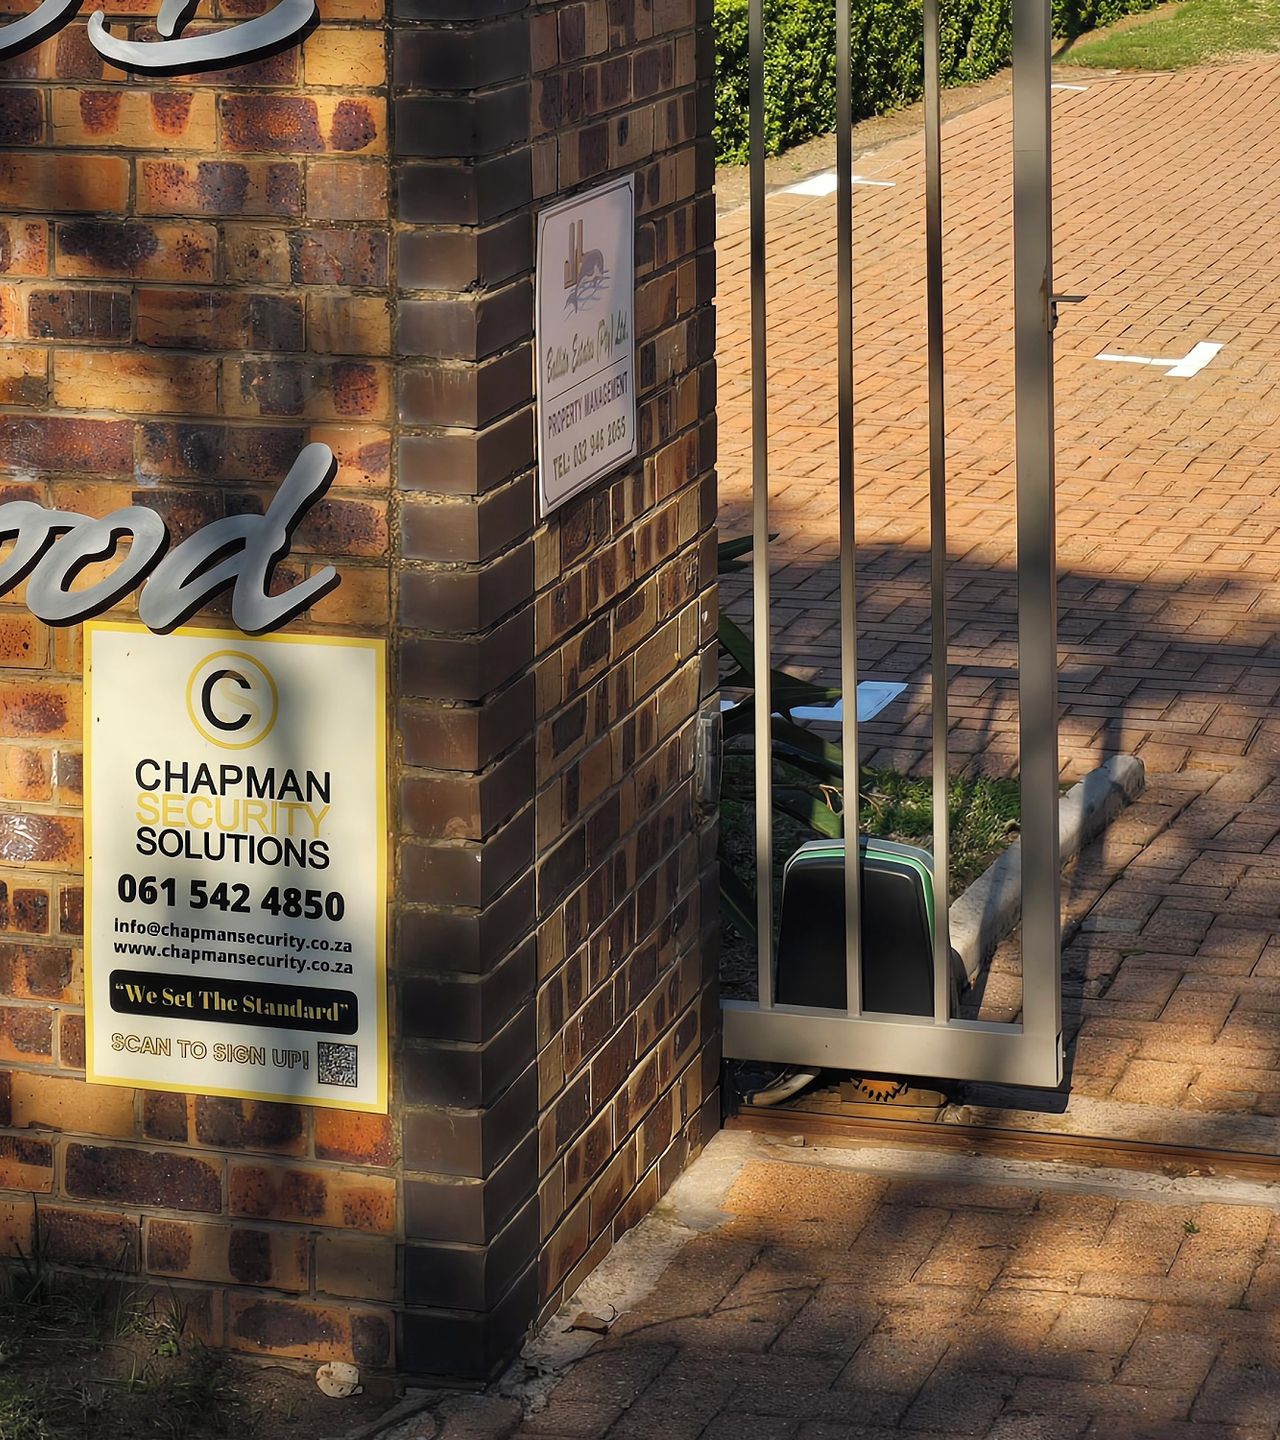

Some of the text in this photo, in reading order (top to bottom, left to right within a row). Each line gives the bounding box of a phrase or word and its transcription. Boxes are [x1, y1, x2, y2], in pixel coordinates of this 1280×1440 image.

[547, 370, 628, 440] PROPERTY MANAGEMENT
[553, 452, 571, 481] TEL:
[135, 758, 331, 804] CHAPMAN
[135, 792, 332, 838] SECURITY
[136, 826, 331, 870] SOLUTIONS
[117, 873, 345, 922] 061 542 4850
[113, 917, 353, 953] info@chapmansecurity.co.za
[113, 941, 354, 974] www.chapmansecurity.co.za
[162, 987, 194, 1008] Set
[198, 990, 238, 1012] The
[111, 1032, 310, 1071] SCAN TO SIGN UP!
